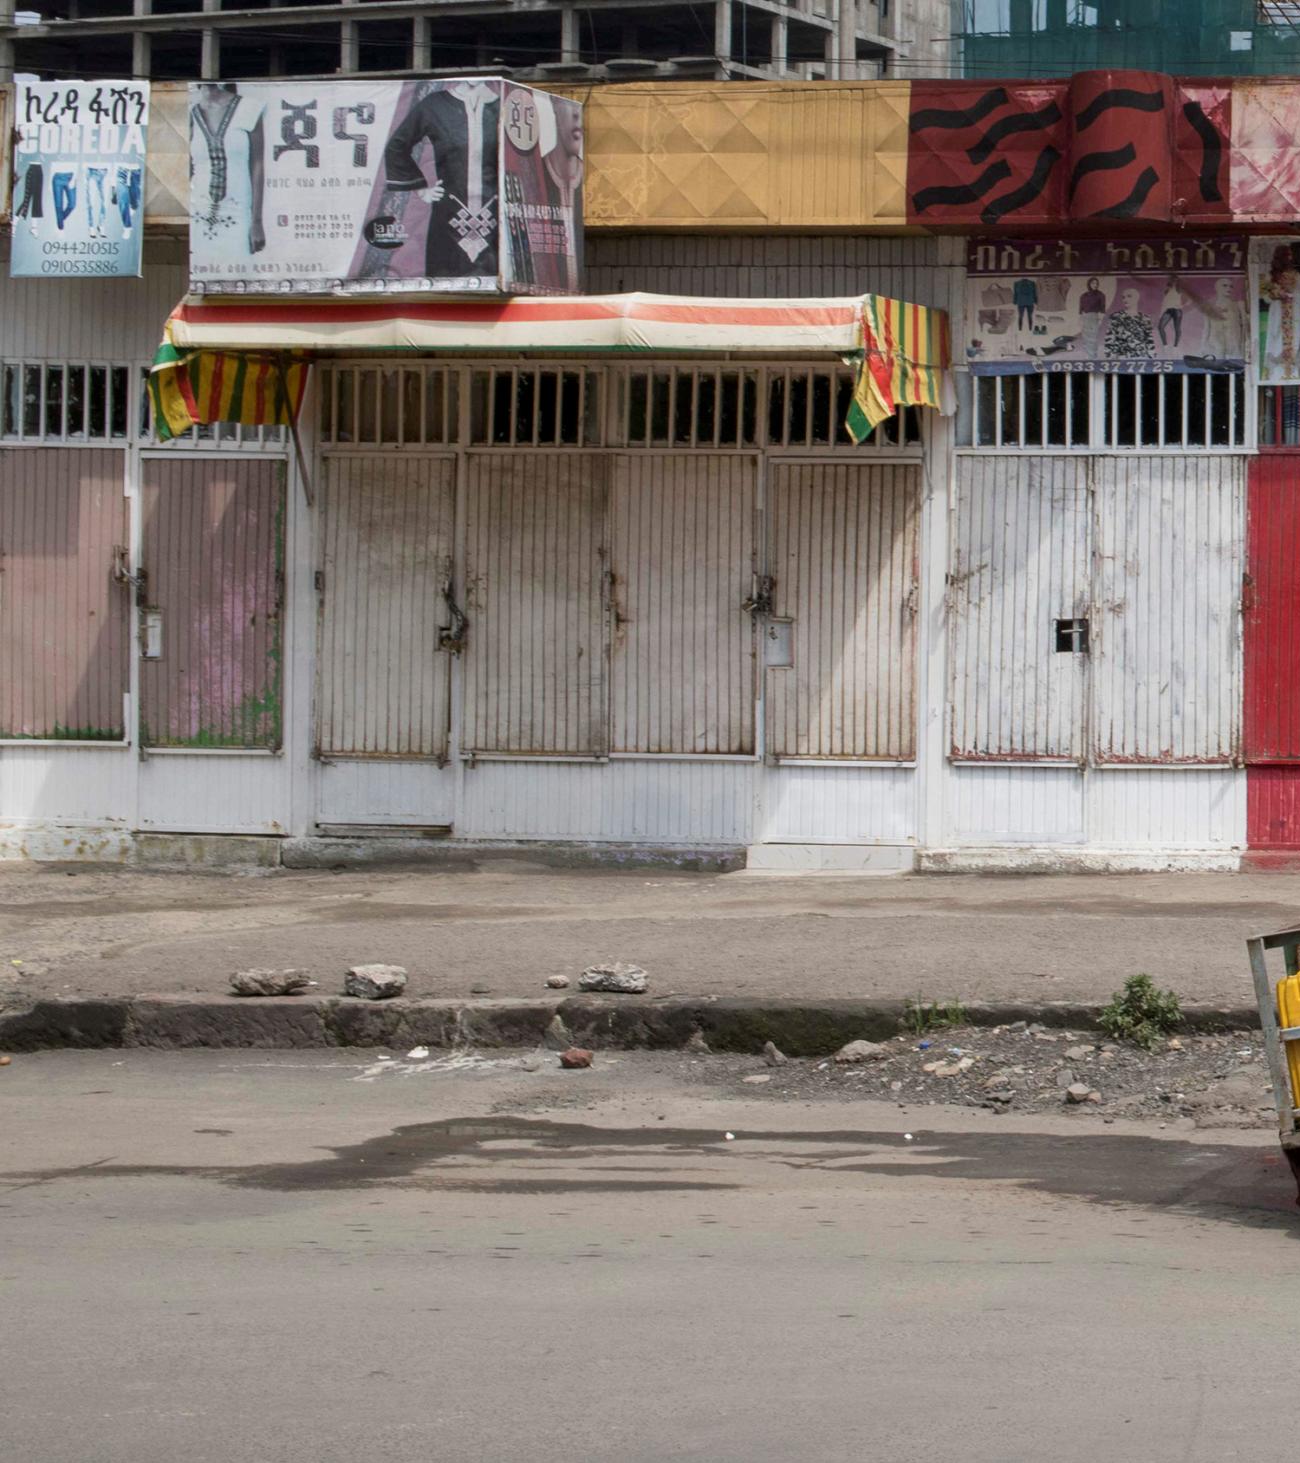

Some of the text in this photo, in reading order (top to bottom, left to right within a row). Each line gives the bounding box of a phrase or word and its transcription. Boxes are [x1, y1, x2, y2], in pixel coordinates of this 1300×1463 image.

[89, 87, 146, 124] ፋሽን
[18, 125, 147, 154] COREDA
[970, 240, 1079, 270] ብስራት
[1051, 361, 1174, 373] 0933 37 77 25
